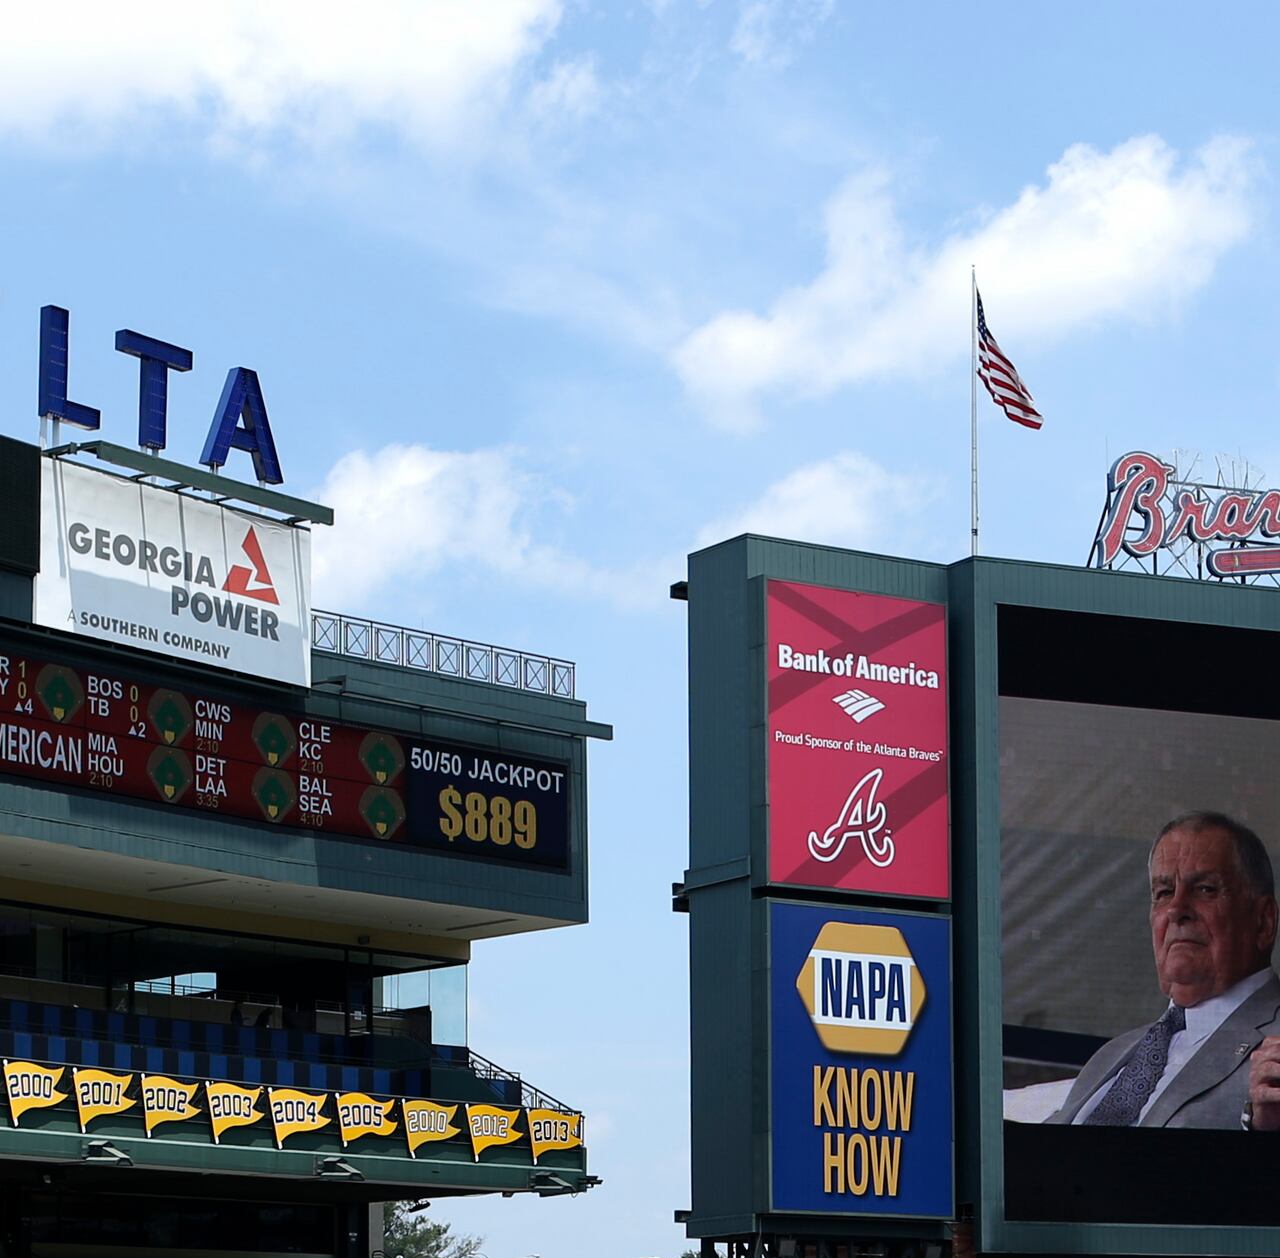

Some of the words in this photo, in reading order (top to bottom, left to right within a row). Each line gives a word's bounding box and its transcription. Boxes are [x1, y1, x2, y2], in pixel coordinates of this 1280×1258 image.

[68, 522, 216, 588] GEORGIA
[171, 585, 280, 642] POWER
[67, 609, 77, 623] A
[81, 611, 158, 642] SOUTHERN
[163, 631, 230, 659] COMPANY
[19, 661, 26, 678] 1
[778, 644, 831, 675] Bank
[832, 652, 855, 677] of
[855, 655, 940, 690] America
[18, 681, 26, 700] 0
[88, 675, 123, 700] BOS
[130, 685, 138, 703] 0
[24, 698, 33, 714] 4
[87, 696, 110, 717] TB
[130, 704, 138, 723] 0
[195, 700, 231, 723] CWS
[137, 722, 146, 738] 2
[195, 719, 223, 741] MIN
[299, 722, 331, 743] CLE
[88, 732, 118, 755] MIA
[196, 738, 219, 754] 2:10
[299, 741, 322, 761] KC
[775, 730, 804, 747] Proud
[805, 734, 843, 751] Sponsor
[843, 738, 855, 752] of
[856, 739, 872, 754] the
[873, 742, 907, 759] Atlanta
[88, 755, 124, 777] HOU
[195, 755, 226, 776] DET
[300, 758, 324, 775] 2:10
[410, 747, 462, 777] 50/50
[468, 757, 564, 794] JACKPOT
[89, 771, 113, 788] 2:10
[195, 774, 227, 797] LAA
[299, 775, 332, 797] BAL
[196, 792, 219, 808] 3:35
[299, 794, 333, 816] SEA
[300, 812, 323, 827] 4:10
[439, 784, 537, 850] $889
[807, 768, 895, 868] A
[821, 957, 907, 1023] NAPA
[8, 1073, 54, 1099] 2000
[78, 1081, 122, 1106] 2001
[812, 1065, 916, 1132] KNOW
[144, 1087, 187, 1114] 2002
[211, 1093, 254, 1118] 2003
[272, 1099, 318, 1124] 2004
[339, 1103, 385, 1128] 2005
[406, 1108, 449, 1134] 2010
[470, 1113, 510, 1138] 2012
[531, 1119, 569, 1143] 2013
[823, 1132, 902, 1197] HOW
